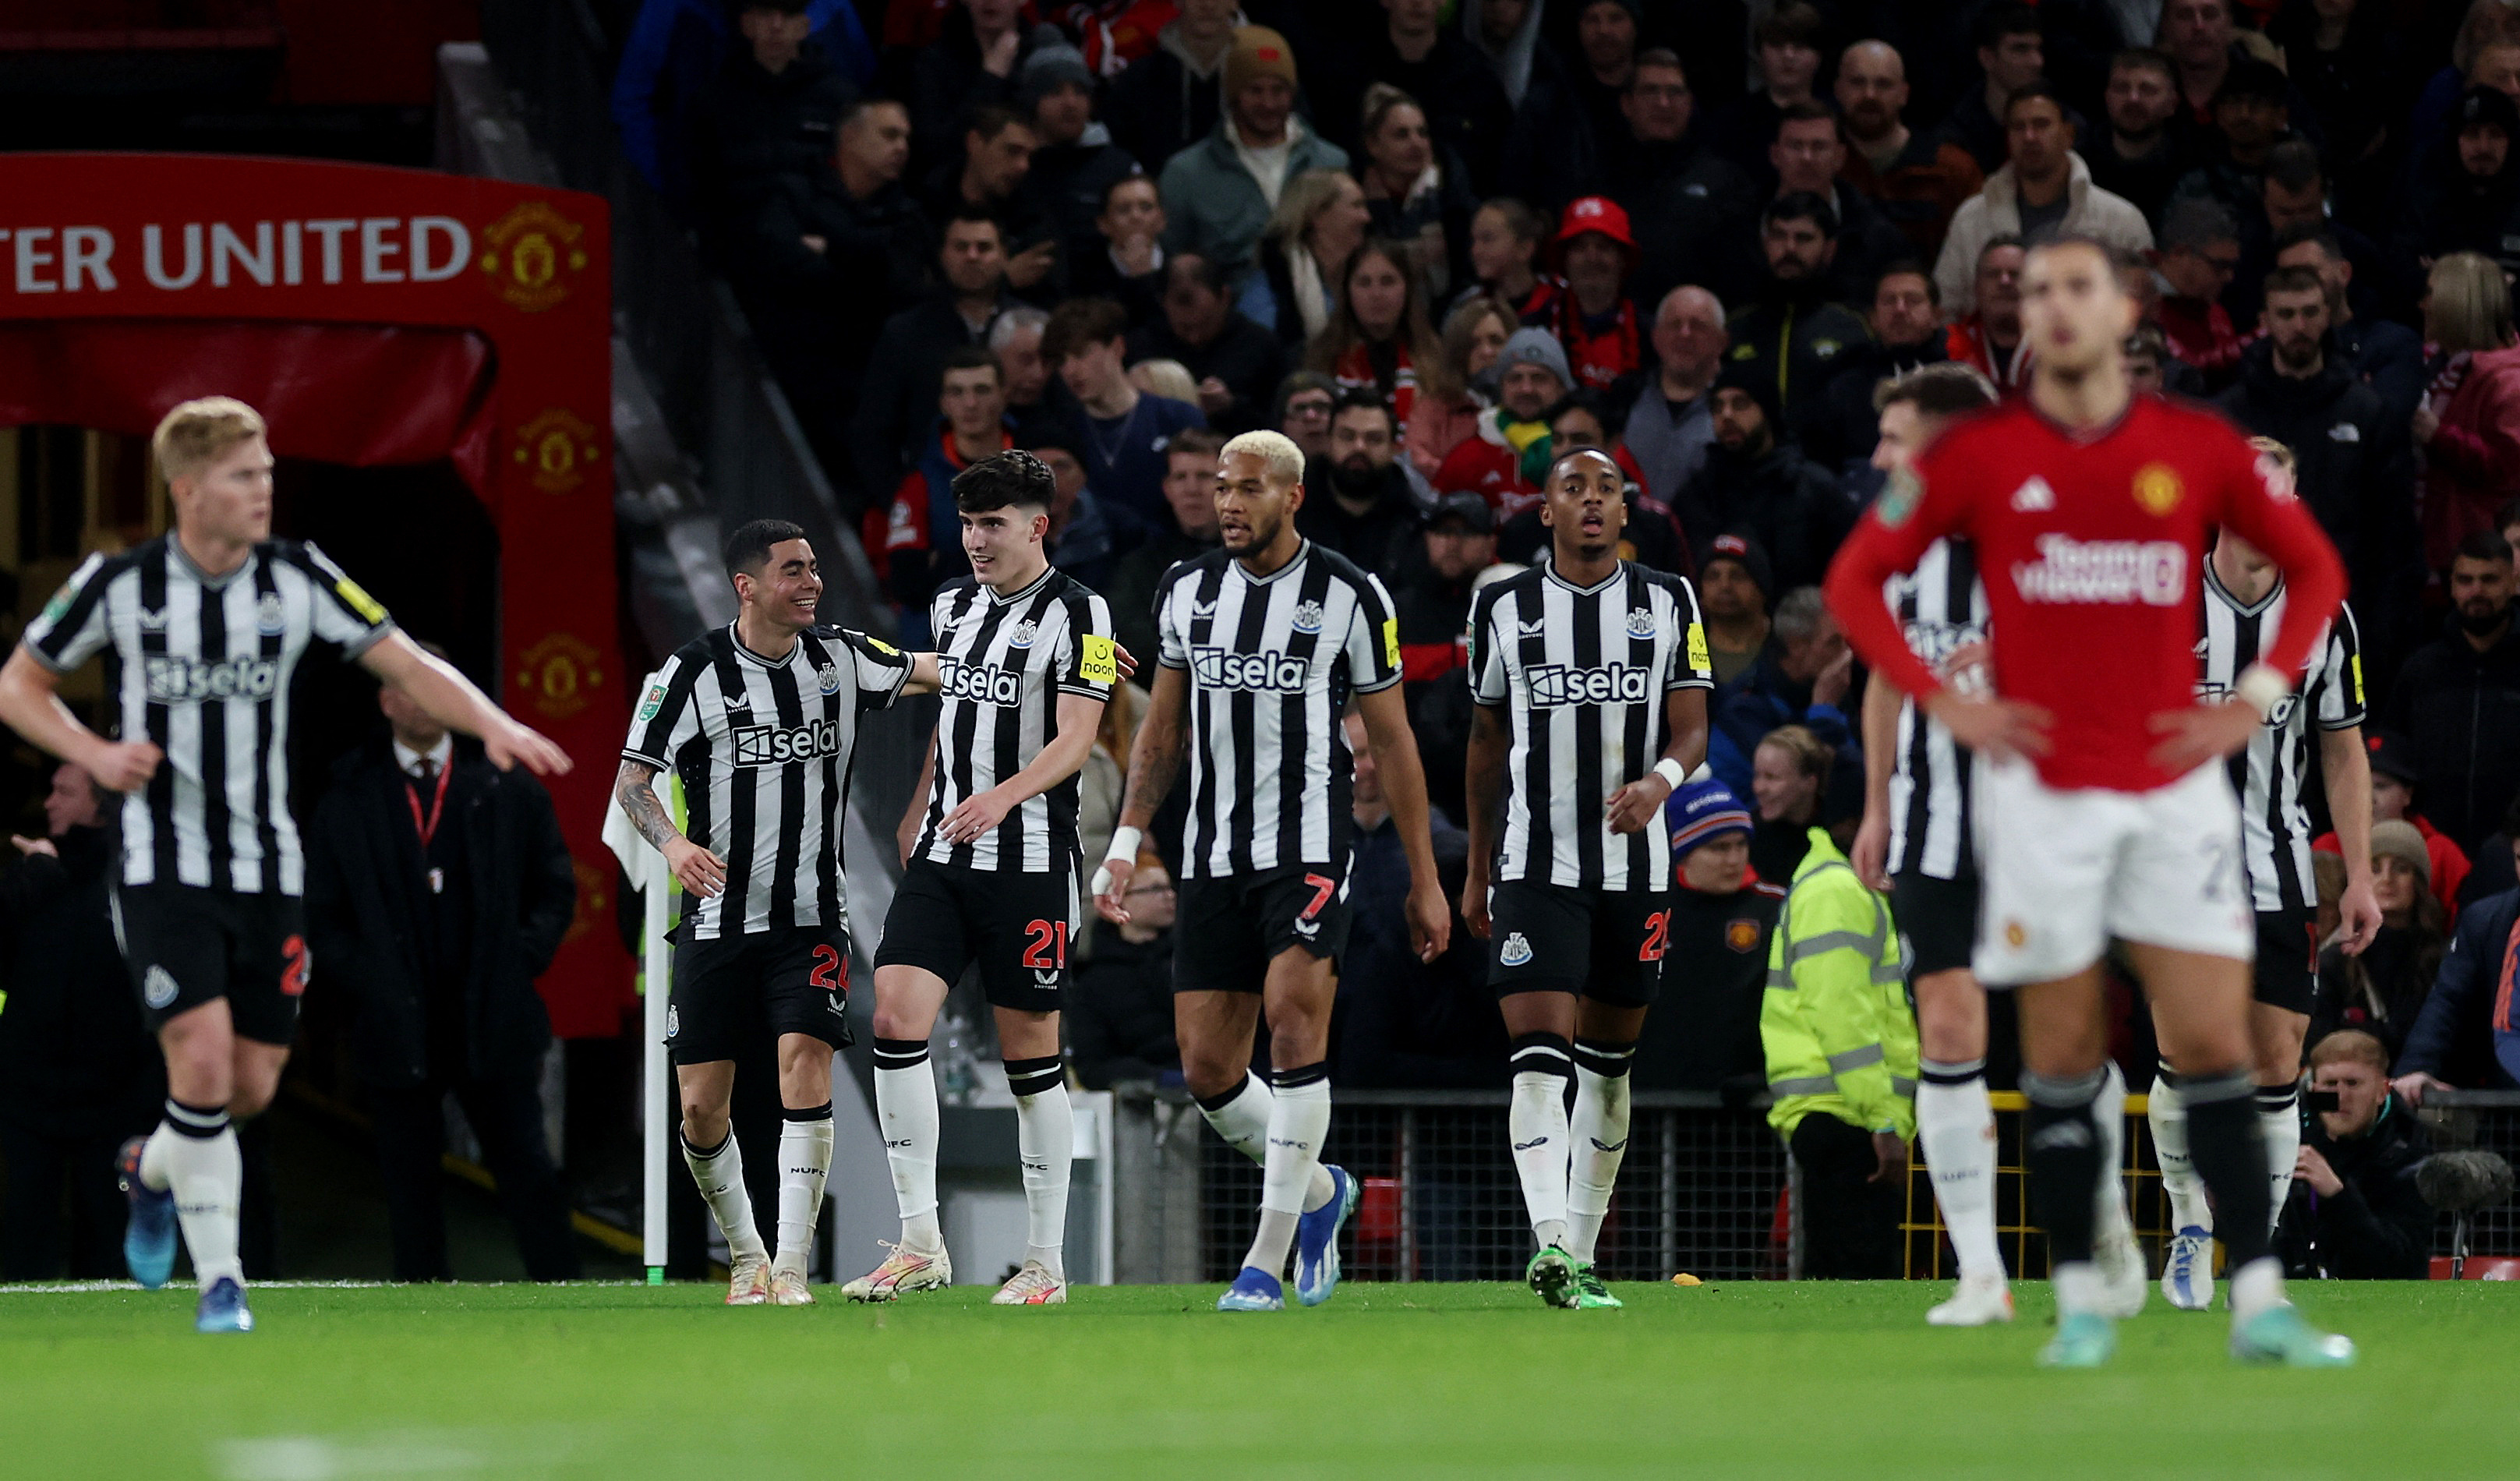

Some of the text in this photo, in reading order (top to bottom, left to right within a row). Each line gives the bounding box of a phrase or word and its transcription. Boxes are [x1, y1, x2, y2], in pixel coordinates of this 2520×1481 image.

[0, 215, 472, 293] ER UNITED
[189, 659, 274, 698] sela
[954, 666, 1016, 702] sela
[1084, 663, 1114, 677] noon
[1225, 652, 1303, 689] sela
[1567, 665, 1646, 700] sela
[773, 722, 836, 758] sela
[1300, 871, 1335, 921] 7
[1023, 919, 1066, 969] 21
[790, 1168, 825, 1178] NUFC
